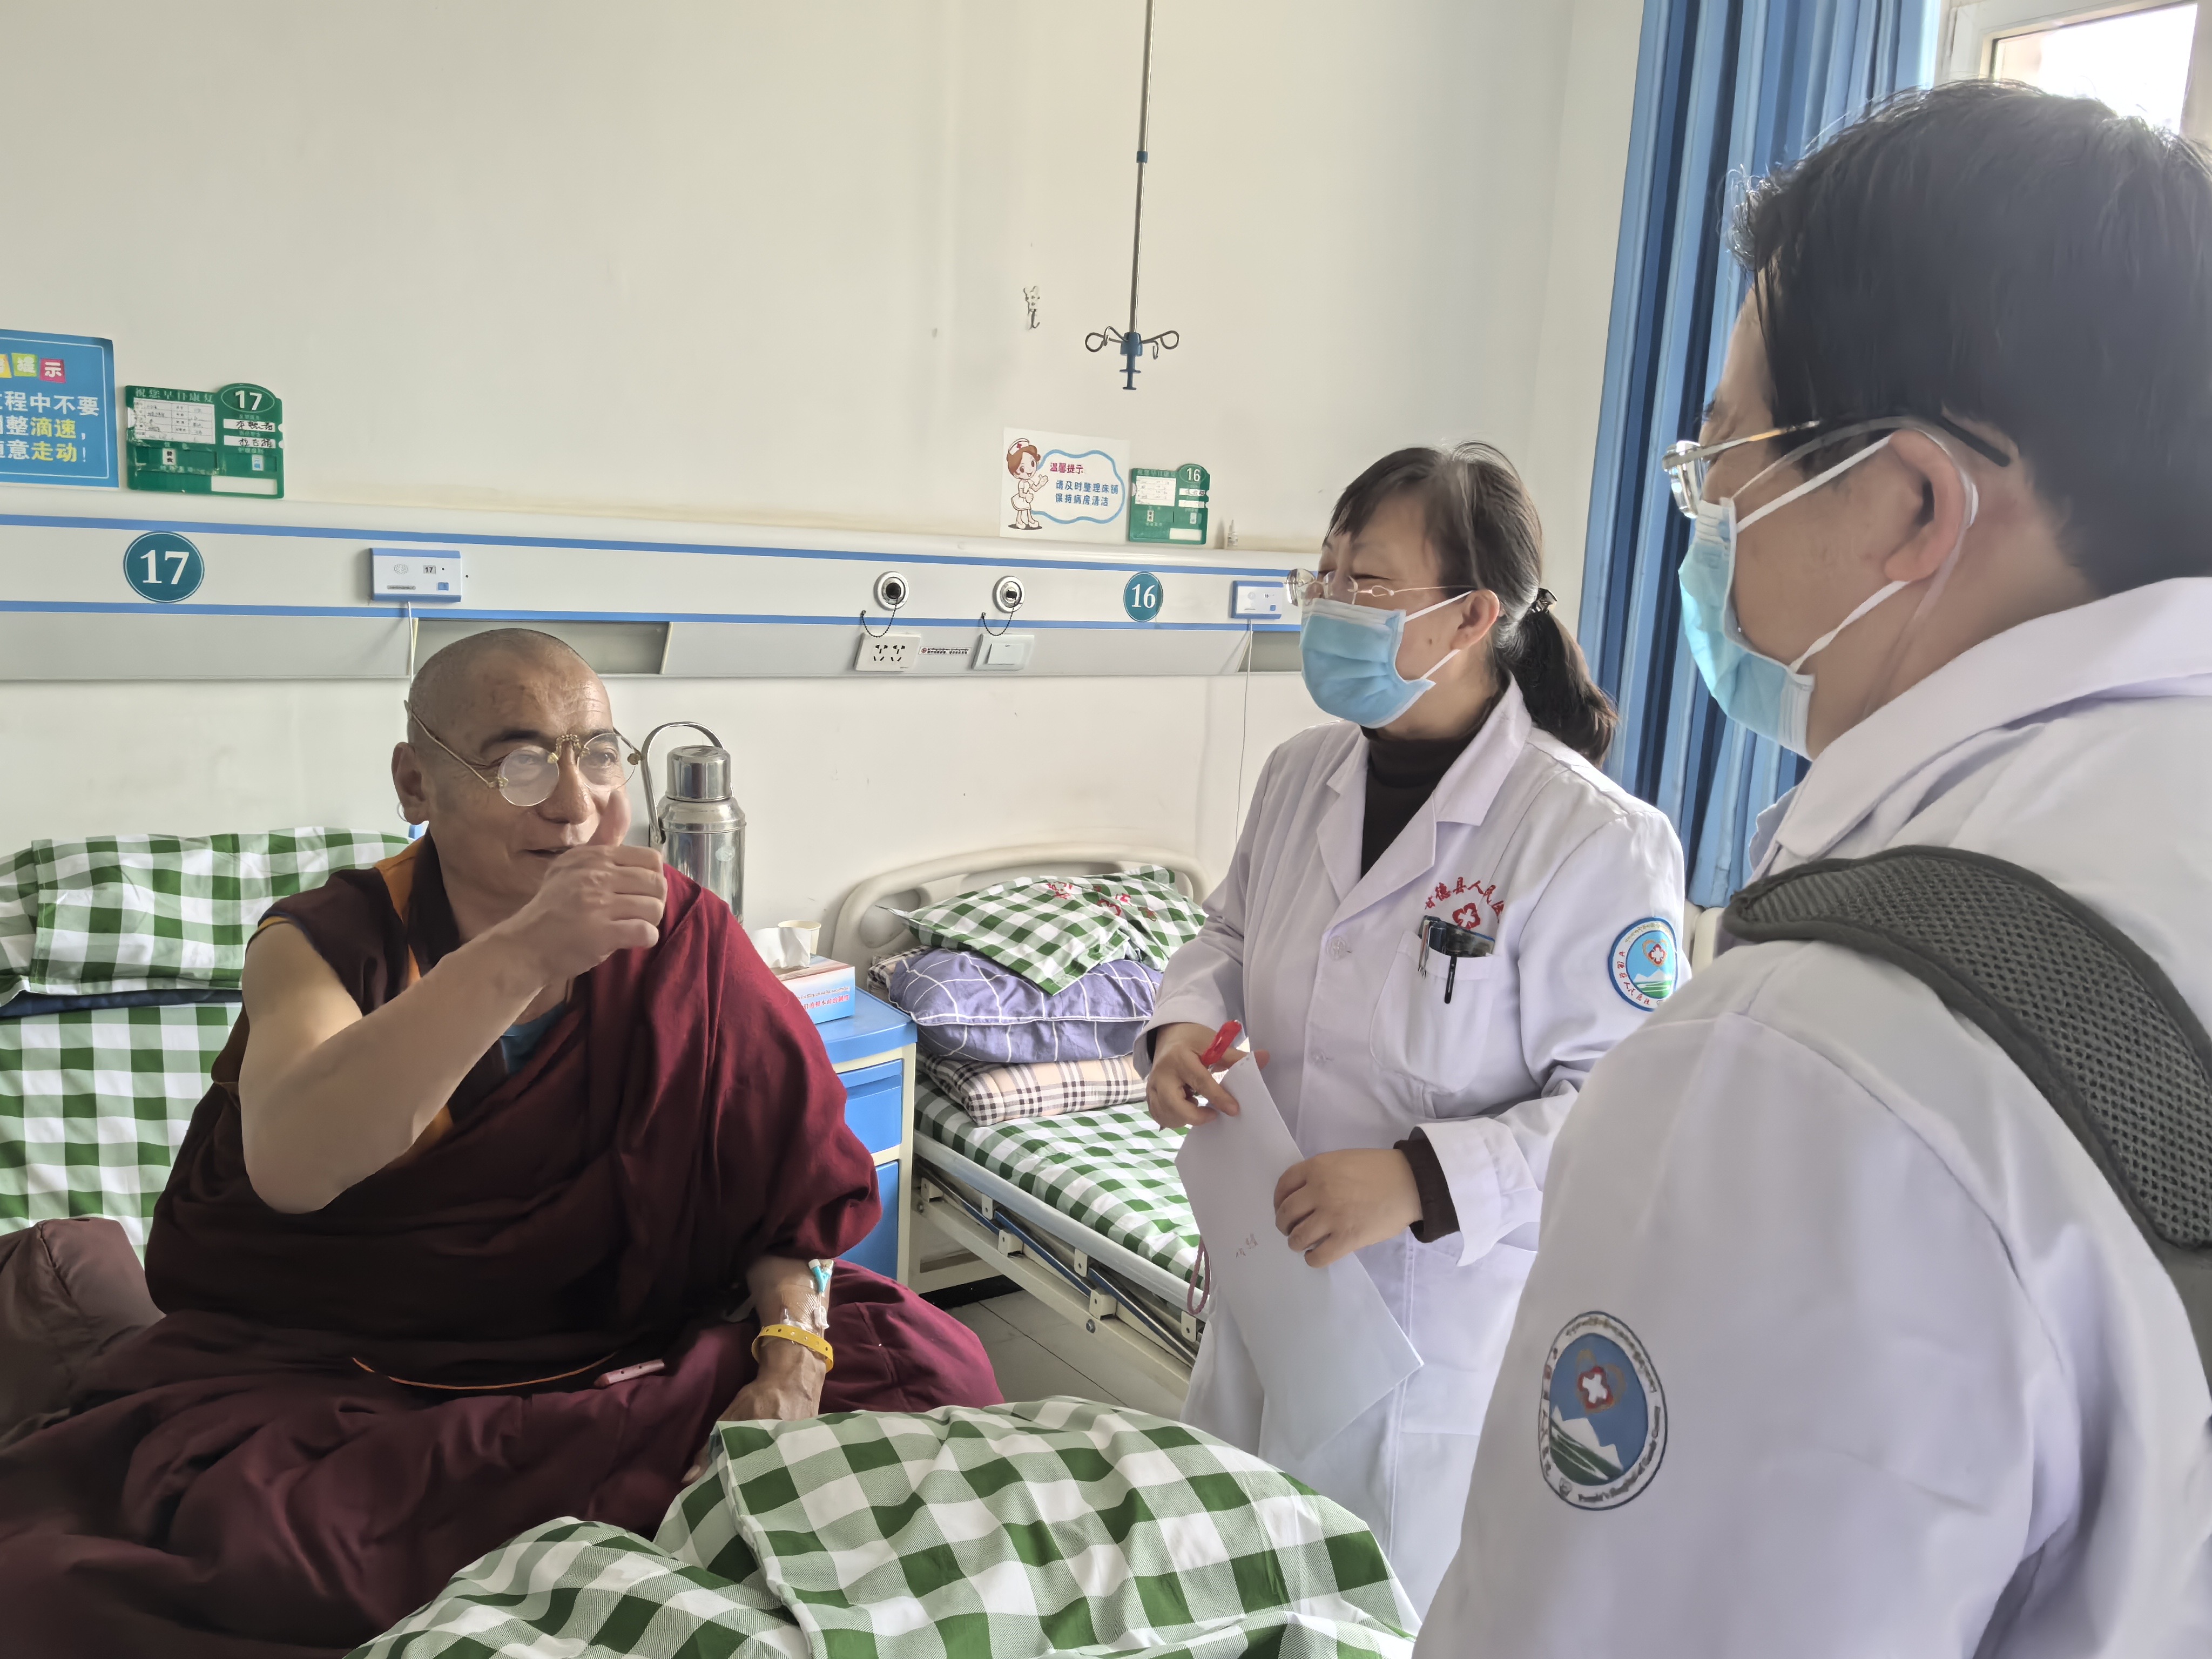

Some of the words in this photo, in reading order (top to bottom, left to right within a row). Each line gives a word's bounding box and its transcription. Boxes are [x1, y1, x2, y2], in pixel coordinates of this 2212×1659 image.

[0, 356, 62, 377] 提示
[0, 390, 100, 416] 程中不要
[235, 390, 262, 411] 17
[0, 415, 86, 440] 整滴速，
[1050, 462, 1083, 474] 温馨提示
[1186, 468, 1201, 482] 16
[1055, 493, 1109, 507] 保持病房清洁
[140, 549, 190, 585] 17
[1131, 583, 1156, 609] 16
